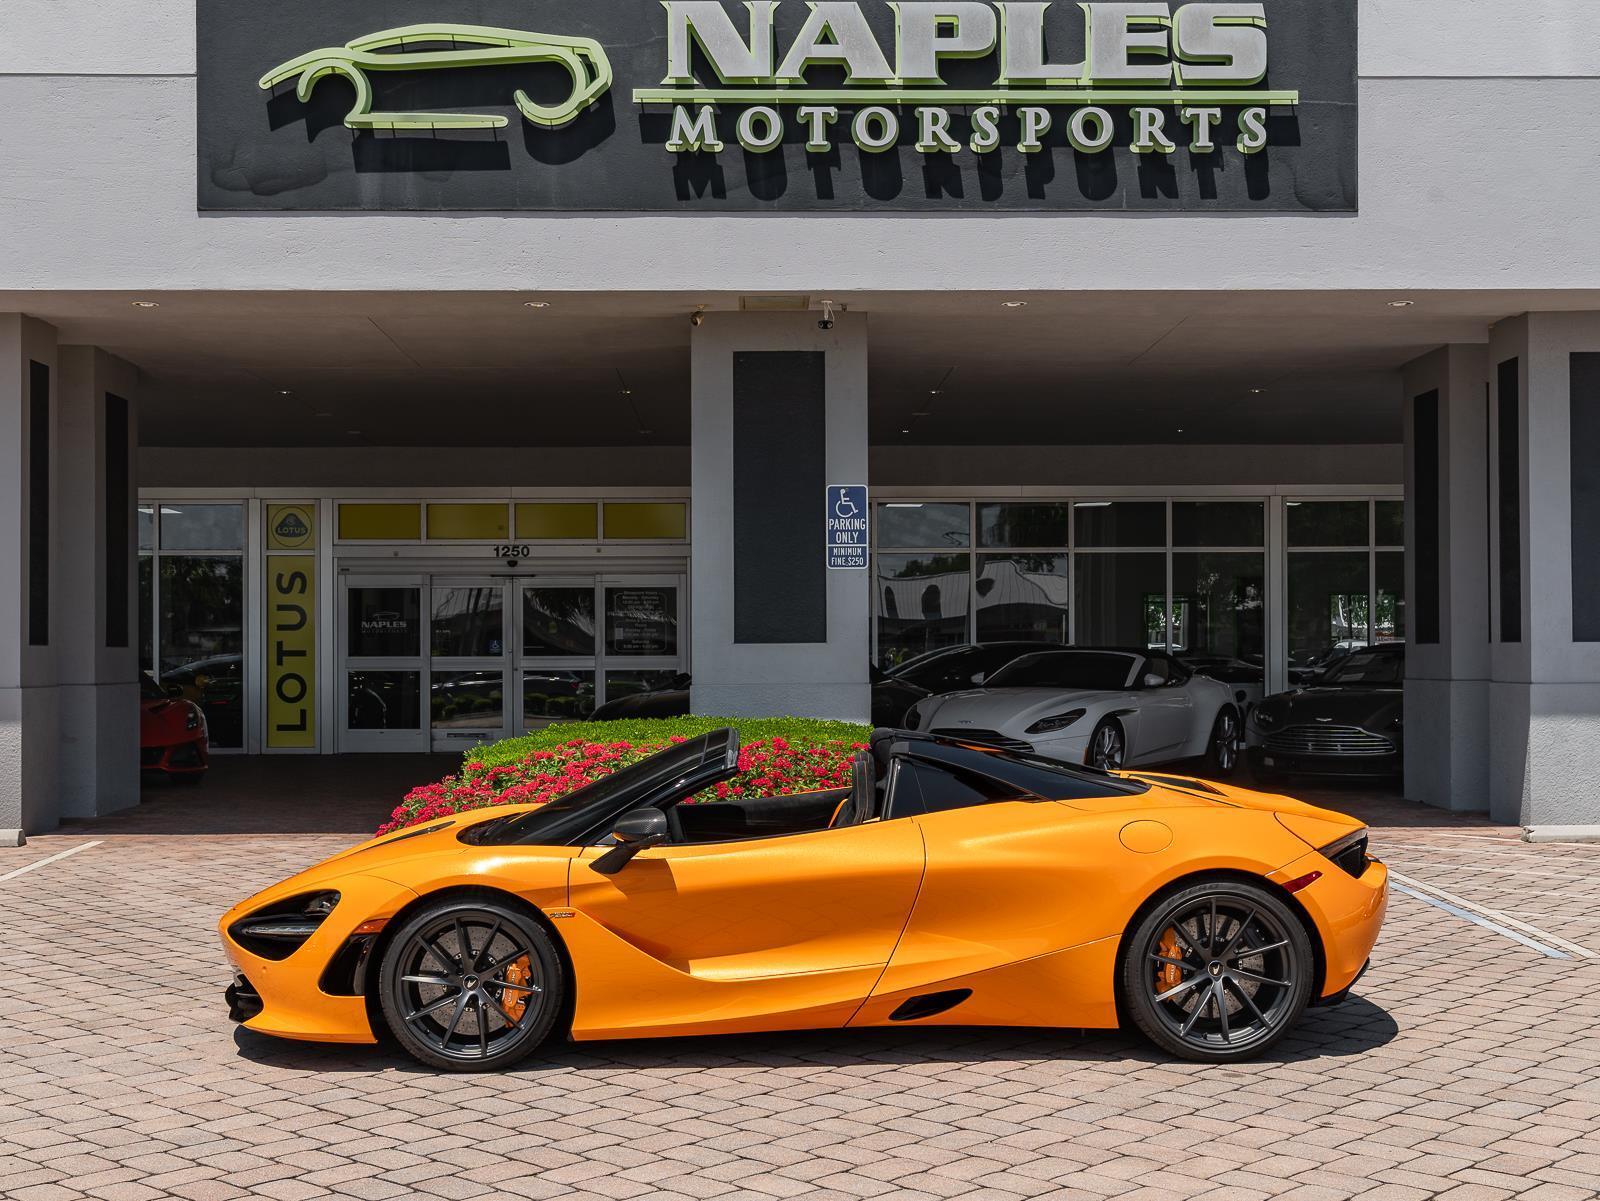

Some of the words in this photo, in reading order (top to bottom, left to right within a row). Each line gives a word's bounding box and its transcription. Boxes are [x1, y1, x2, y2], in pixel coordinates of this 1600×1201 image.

[660, 1, 1267, 85] NAPLES
[666, 105, 1267, 152] MOTORSPORTS
[828, 518, 866, 530] PARKING
[277, 527, 307, 535] LOTUS
[835, 532, 859, 544] ONLY
[494, 545, 530, 557] 1250
[833, 547, 862, 556] MINIMUM
[831, 557, 846, 566] FINE
[847, 556, 864, 566] $250
[276, 572, 307, 732] LOTUS
